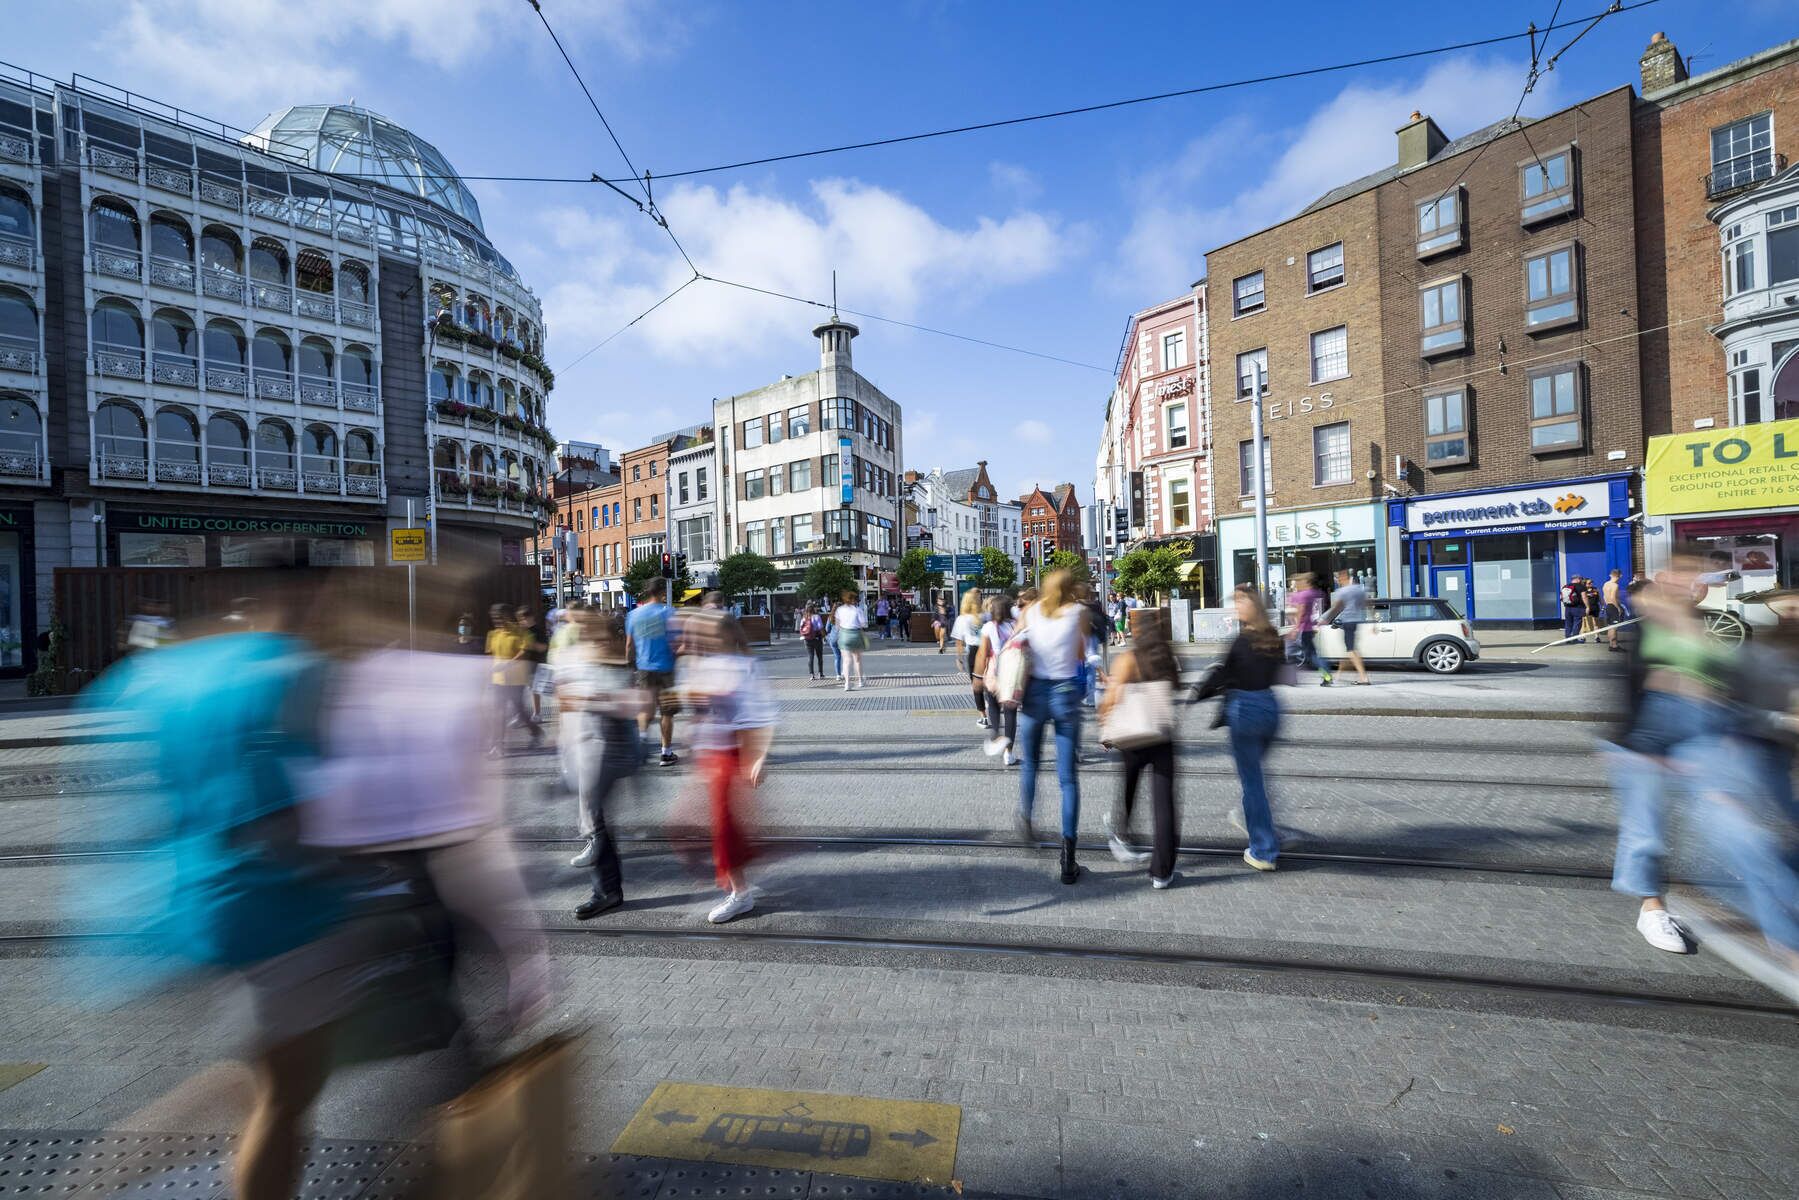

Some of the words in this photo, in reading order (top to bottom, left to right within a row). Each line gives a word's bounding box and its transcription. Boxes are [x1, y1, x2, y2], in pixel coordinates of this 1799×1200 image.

[1251, 392, 1335, 423] EISS
[1685, 438, 1752, 467] TO
[1669, 468, 1745, 483] EXCEPTIONAL
[1748, 464, 1787, 475] RETAIL
[1670, 481, 1723, 493] GROUND
[1726, 476, 1768, 488] FLOOR
[1770, 474, 1799, 483] RETA
[1717, 488, 1757, 499] ENTIRE
[1761, 486, 1783, 495] 716
[1423, 502, 1519, 528] permanent
[1519, 496, 1553, 517] tsb
[138, 515, 201, 529] UNITED
[203, 519, 269, 532] COLORS
[270, 521, 292, 533] OF
[1423, 530, 1449, 538] Savings
[1464, 527, 1491, 535] Current
[1492, 525, 1526, 533] Accounts
[1544, 520, 1588, 530] Mortgages
